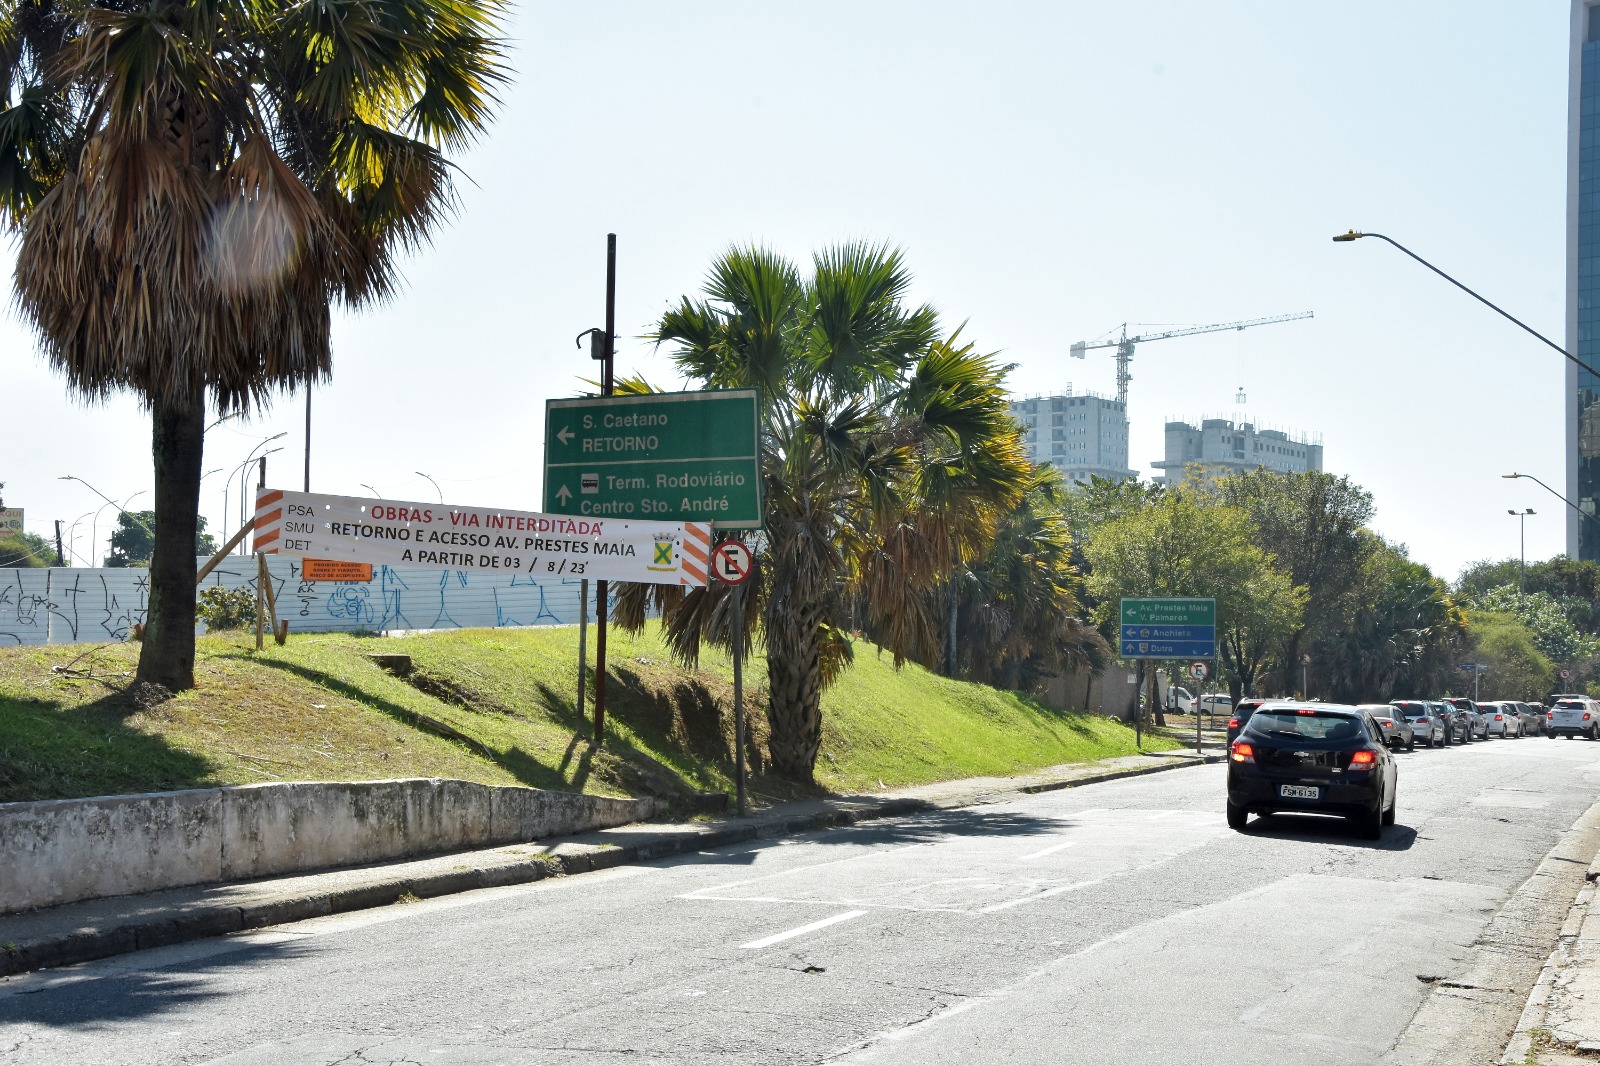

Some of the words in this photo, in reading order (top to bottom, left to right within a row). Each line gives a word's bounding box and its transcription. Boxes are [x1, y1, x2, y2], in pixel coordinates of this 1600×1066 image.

[583, 415, 597, 429] S.
[604, 413, 669, 429] Caetano
[582, 436, 659, 453] RETORNO
[606, 475, 650, 490] Term.
[656, 471, 745, 489] Rodoviário
[287, 504, 315, 517] PSA
[581, 499, 635, 515] Centro
[641, 498, 673, 513] Sto.
[680, 495, 729, 512] André
[284, 521, 315, 534] SMU
[371, 505, 433, 524] OBRAS
[449, 511, 480, 528] VIA
[485, 514, 602, 536] INTERDITADA
[284, 539, 312, 552] DET
[330, 522, 410, 542] RETORNO
[415, 530, 424, 542] E
[428, 530, 491, 547] ACESSO
[494, 536, 519, 550] AV.
[524, 537, 589, 554] PRESTES
[593, 542, 636, 557] MAIA
[401, 549, 413, 562] A
[418, 550, 474, 567] PARTIR
[479, 555, 500, 568] DE
[1140, 604, 1152, 612] Av.
[1154, 604, 1187, 612] Prestes
[1188, 604, 1208, 612] Maia
[1149, 613, 1188, 621] Palmares
[1153, 629, 1191, 637] Anchieta
